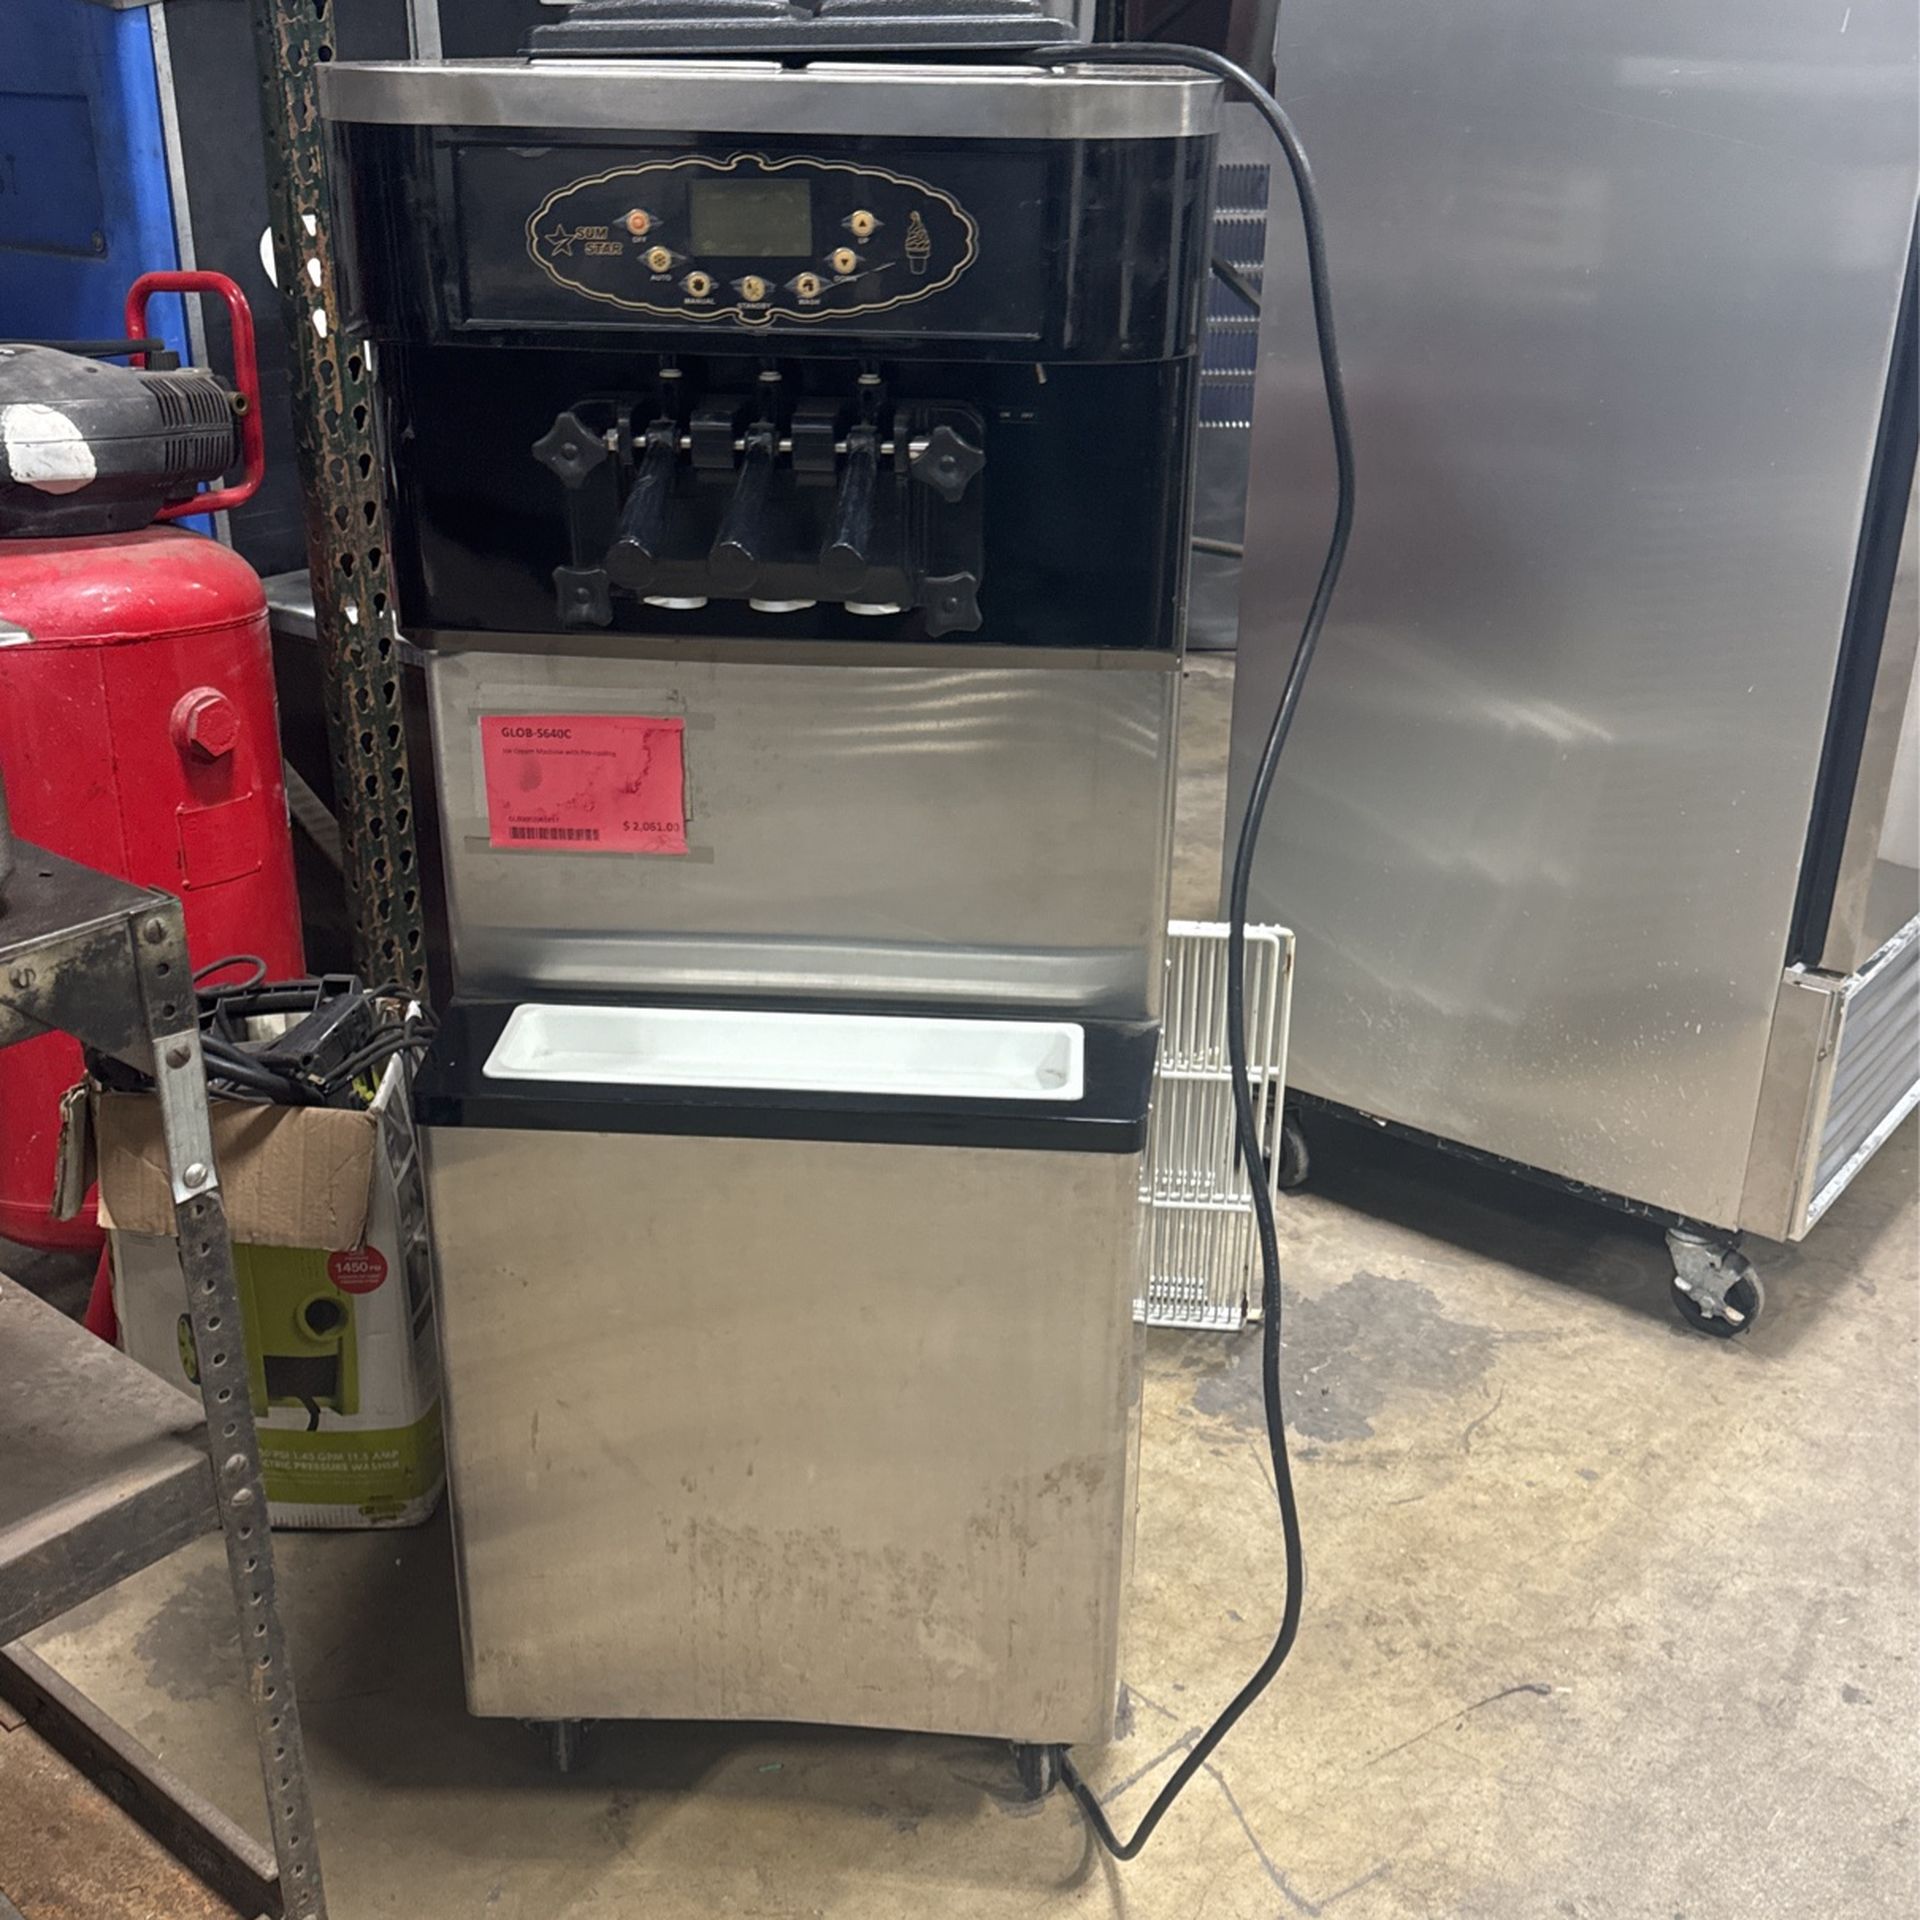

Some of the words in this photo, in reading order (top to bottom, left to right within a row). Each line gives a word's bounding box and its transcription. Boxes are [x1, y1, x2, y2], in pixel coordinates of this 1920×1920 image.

[575, 226, 608, 240] SUM
[584, 242, 624, 256] STAR
[335, 1262, 368, 1273] 1450
